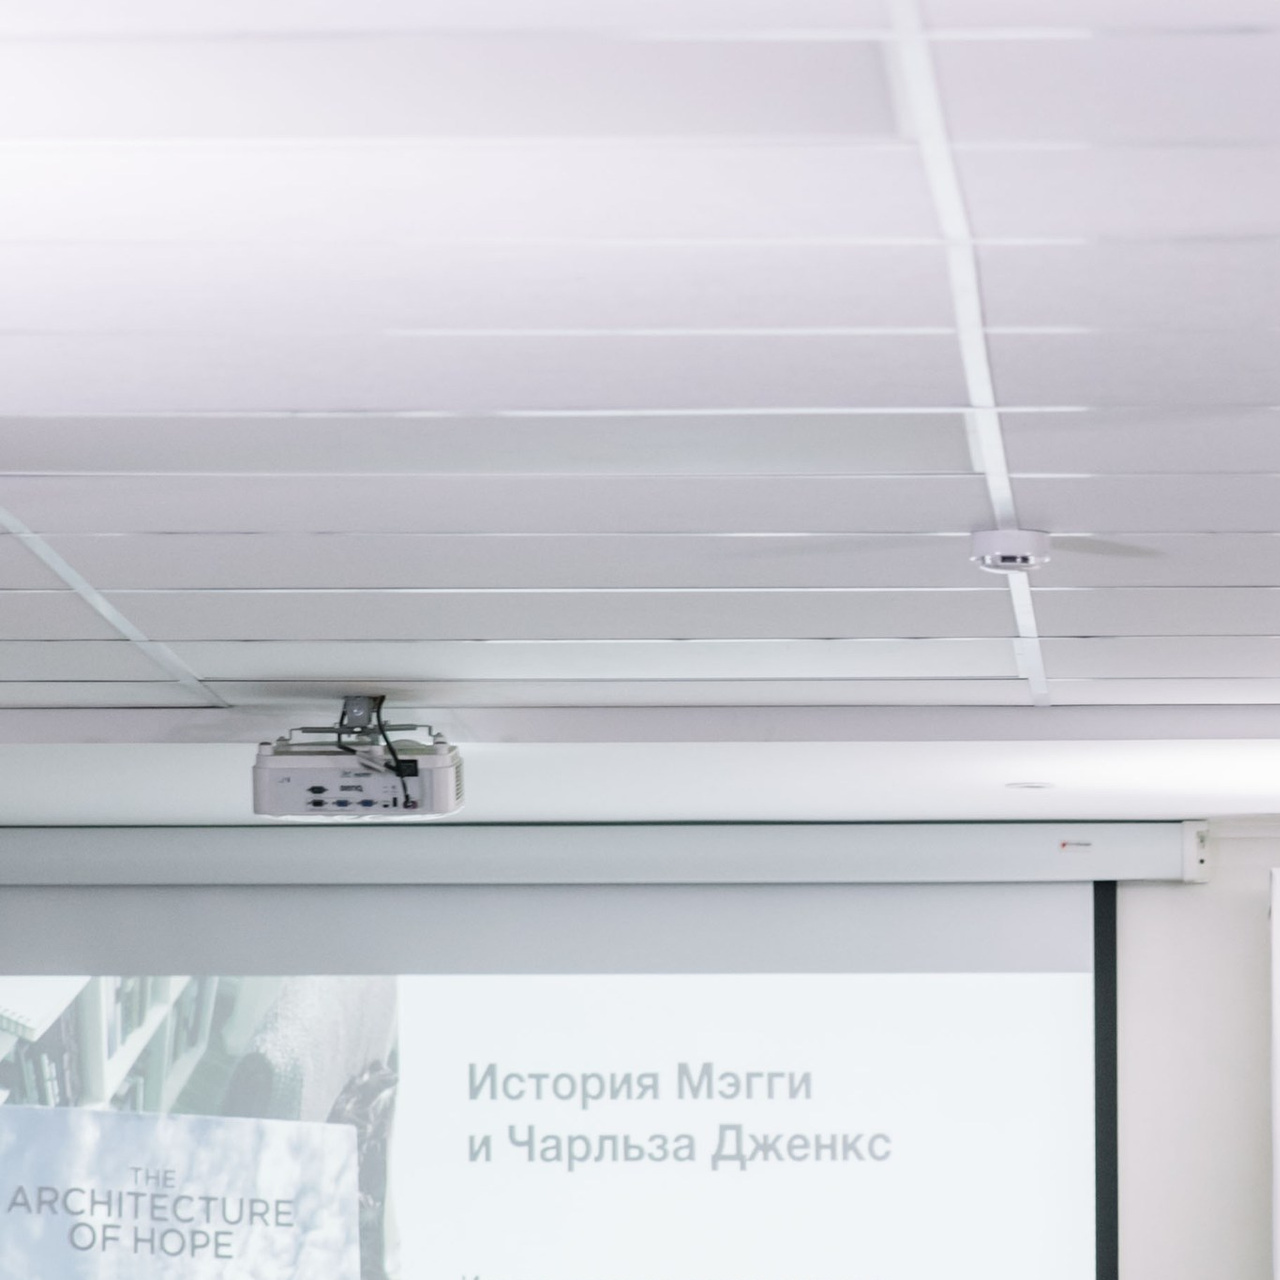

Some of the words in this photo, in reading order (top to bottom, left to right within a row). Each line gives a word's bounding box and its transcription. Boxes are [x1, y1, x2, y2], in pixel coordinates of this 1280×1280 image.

[468, 1062, 660, 1111] История
[677, 1062, 812, 1100] Мэгги
[468, 1134, 492, 1163] и
[507, 1124, 696, 1172] Чарльза
[711, 1123, 892, 1172] Дженкс
[130, 1166, 176, 1189] THE
[7, 1185, 295, 1227] ARCHITECTURE
[69, 1222, 122, 1252] OF
[133, 1226, 235, 1260] HOPE
